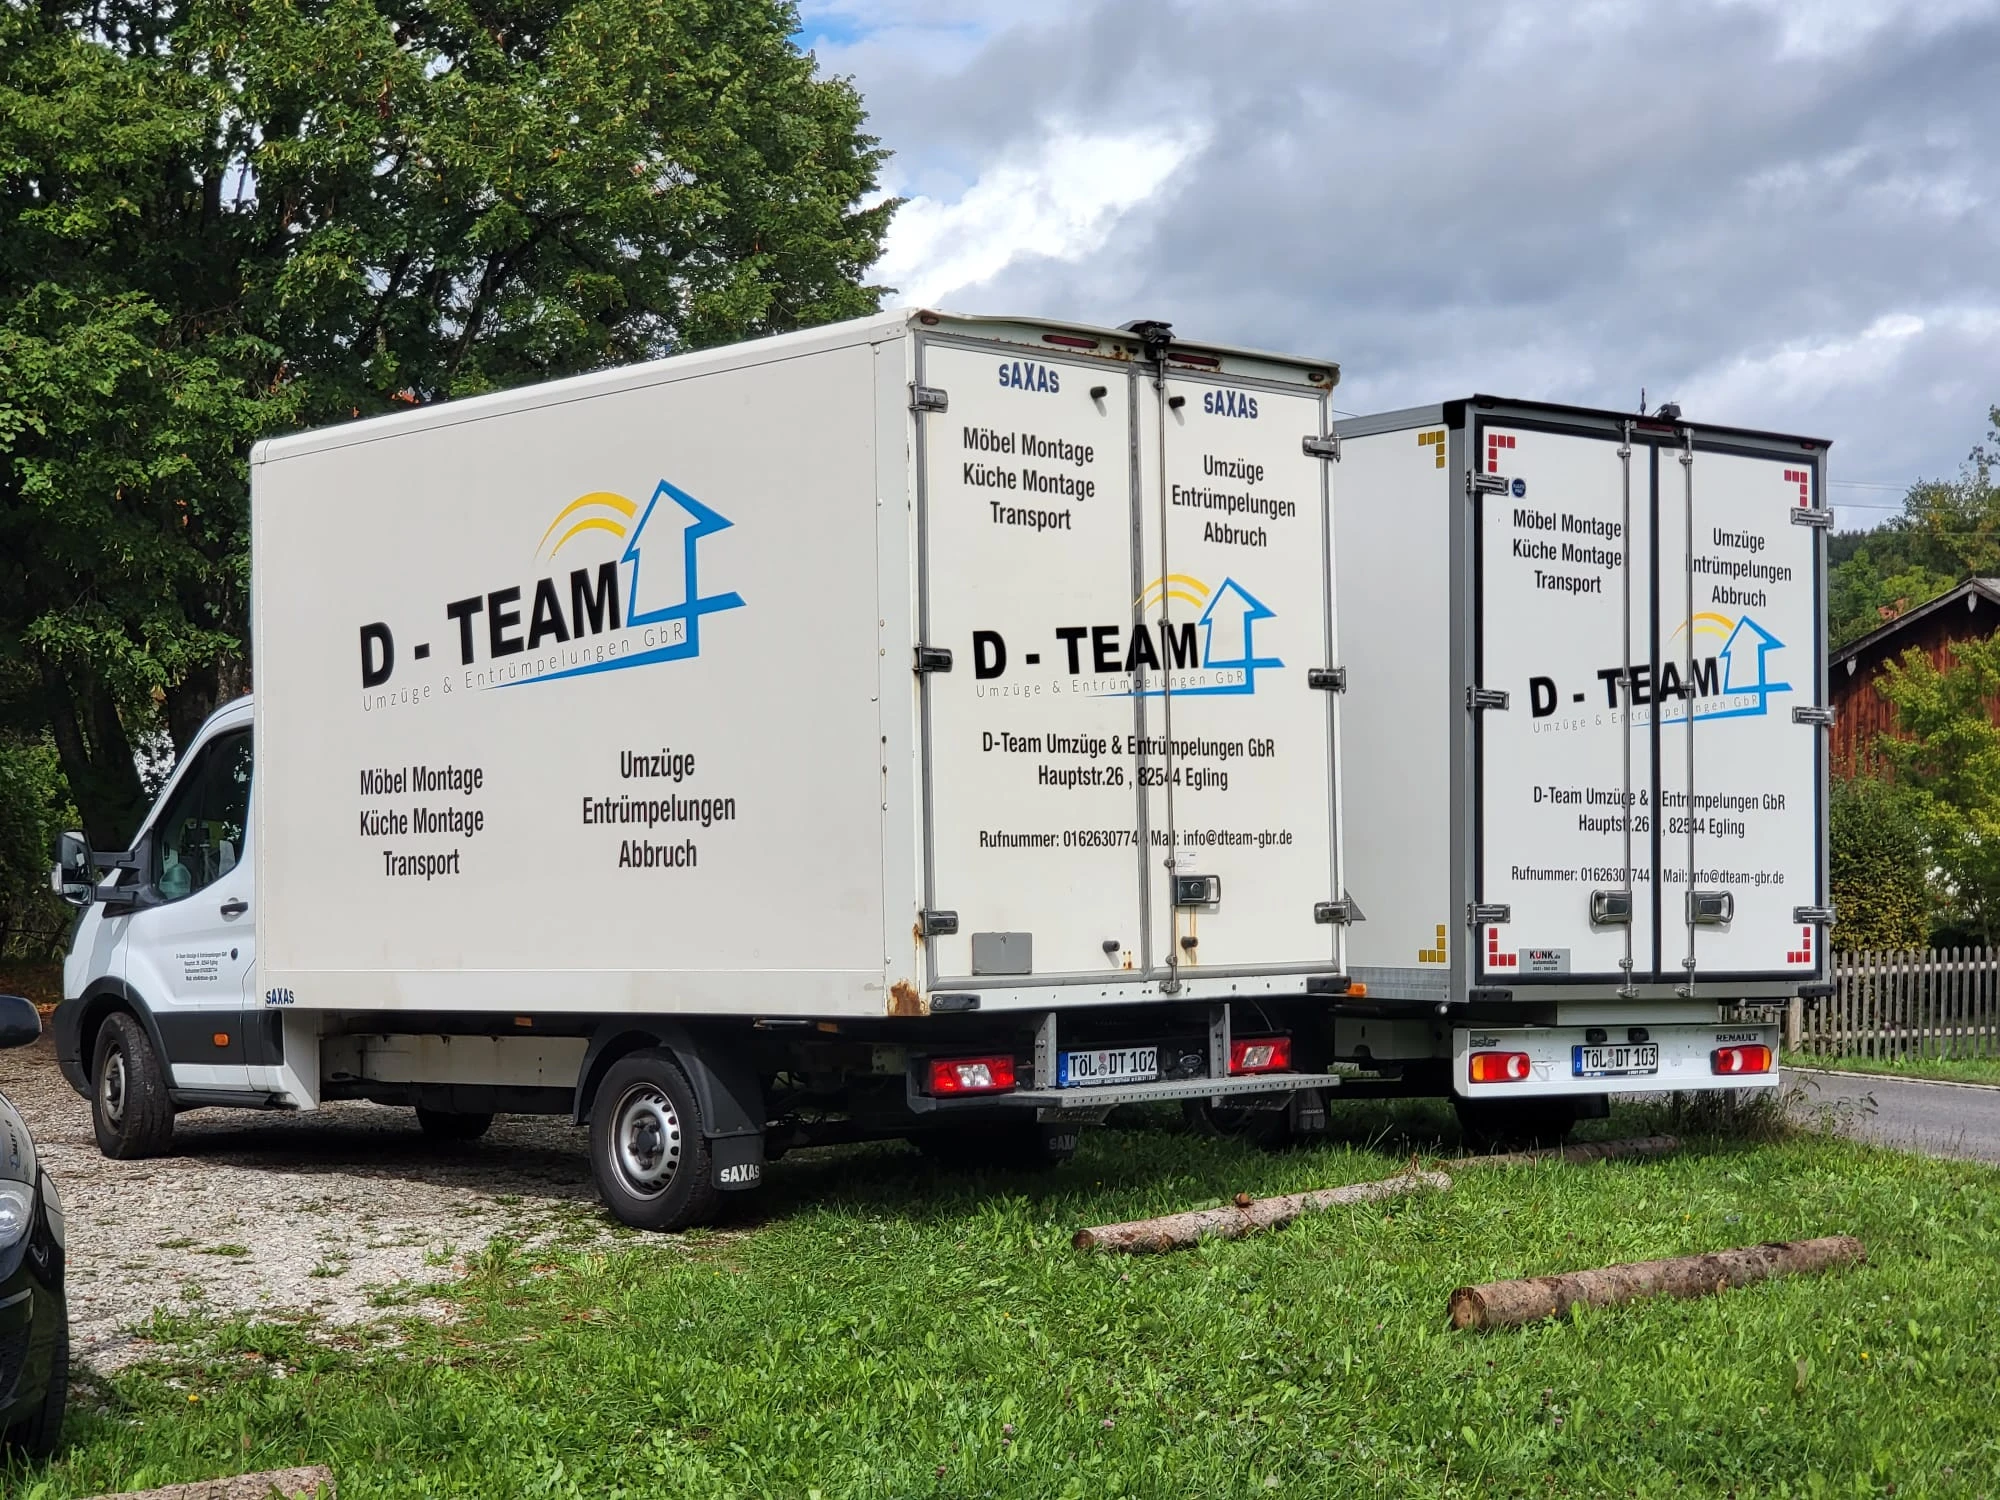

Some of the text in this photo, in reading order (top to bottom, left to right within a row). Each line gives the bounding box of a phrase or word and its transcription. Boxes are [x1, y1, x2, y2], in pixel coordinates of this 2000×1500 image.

[999, 361, 1060, 394] SAXAS
[1204, 389, 1259, 420] SAXAS
[963, 426, 1094, 468] Möbel Montage
[963, 463, 1095, 501] Küche Montage
[1204, 455, 1264, 485] Umzüge
[990, 501, 1071, 532] Transport
[1172, 484, 1296, 520] Entrümpelungen
[1204, 522, 1267, 548] Abbruch
[1513, 508, 1622, 539] Möbel Montage
[1513, 538, 1622, 569] Küche Montage
[1713, 528, 1765, 553] Umzüge
[1534, 570, 1602, 595] Transport
[1686, 553, 1792, 584] ntrümpelungen
[1712, 585, 1766, 608] Abbruch
[447, 560, 621, 666] TEAM
[1056, 622, 1199, 675] TEAM
[363, 621, 685, 712] Umzüge & Entrümpelungen GbR
[977, 681, 1041, 699] Umzüge
[1052, 680, 1062, 694] &
[1216, 670, 1244, 684] GbR
[1597, 656, 1720, 709] TEAM
[1533, 695, 1758, 734] Umzüge & Entrüpelngen GbR
[983, 731, 1275, 761] D-Team Umzüge & Entrümpelungen GbR
[360, 765, 484, 797] Möbel Montage
[620, 748, 695, 783] Umzüge
[1038, 765, 1124, 789] Hauptstr.26
[1185, 768, 1229, 791] Egling
[583, 793, 736, 828] Entrümpelungen
[1533, 785, 1582, 806] D-Team
[1640, 789, 1649, 807] &
[1763, 793, 1786, 811] GbR
[360, 807, 484, 838] Küche Montage
[1579, 814, 1649, 836] Hauptst.26
[1669, 817, 1705, 834] 82544
[1709, 818, 1745, 839] Egling
[619, 840, 698, 869] Abbruch
[979, 829, 1293, 850] Rufnummer: 0162630774 Mal: info@dteam-gbr.de
[384, 849, 460, 881] Transport
[1512, 865, 1785, 887] Rufnummer: 0162630744 Mail: nfo@dteam-gbr.de
[265, 987, 295, 1005] SAXAS
[1716, 1032, 1759, 1042] RENAULT
[1070, 1054, 1098, 1078] TÖL
[1109, 1051, 1127, 1075] DT
[1130, 1050, 1157, 1073] 102
[1583, 1049, 1607, 1069] TÖL
[1616, 1048, 1631, 1067] DT
[1634, 1047, 1656, 1067] 103
[720, 1163, 760, 1183] SAXAS
